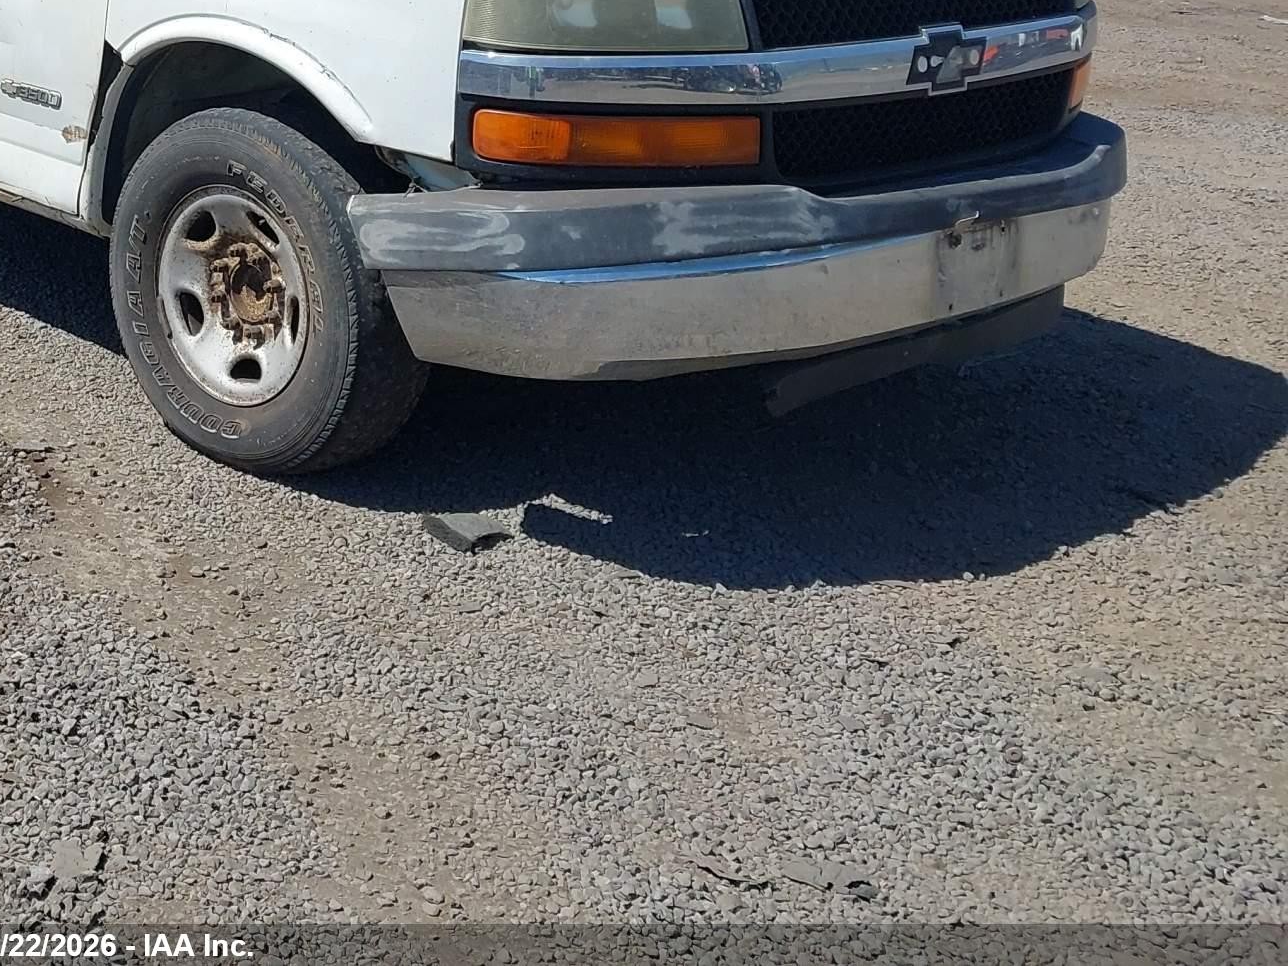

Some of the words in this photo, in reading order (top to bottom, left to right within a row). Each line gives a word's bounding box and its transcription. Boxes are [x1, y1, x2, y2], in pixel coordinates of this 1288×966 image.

[19, 84, 62, 110] 3500
[226, 159, 325, 337] FEDERAL
[127, 290, 243, 440] COURAGIA
